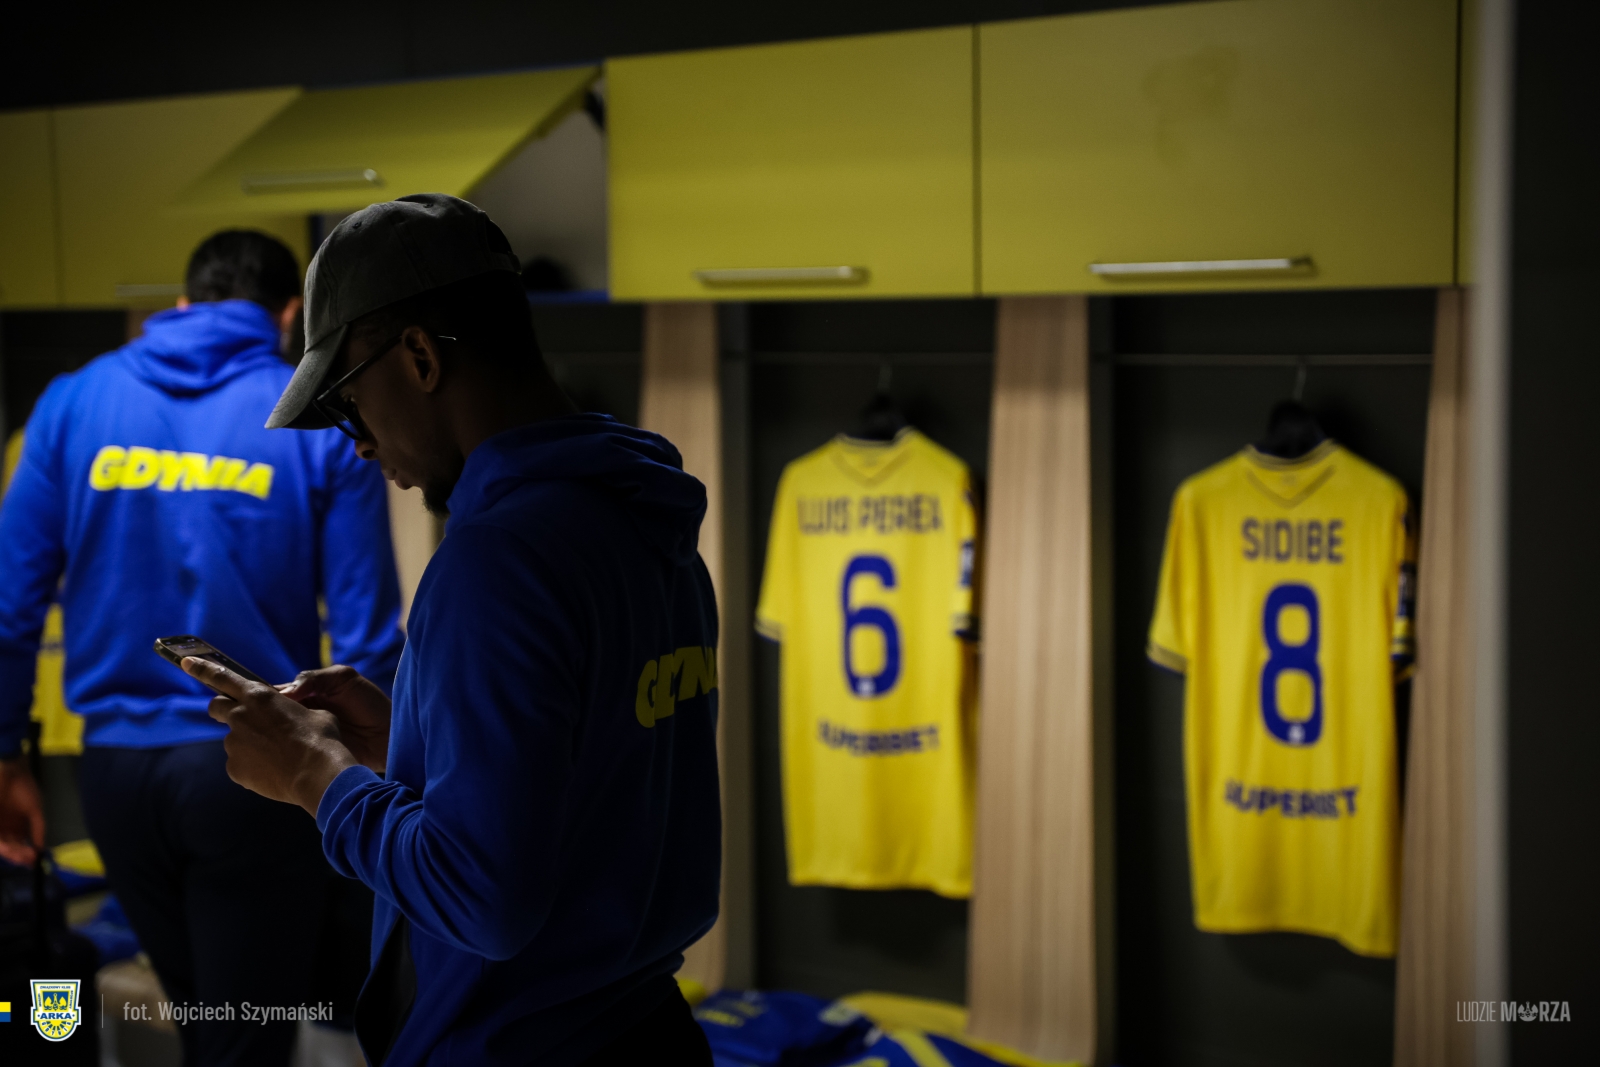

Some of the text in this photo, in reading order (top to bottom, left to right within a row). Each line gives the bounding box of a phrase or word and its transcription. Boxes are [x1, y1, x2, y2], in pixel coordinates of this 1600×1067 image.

[89, 445, 275, 500] GDYNIA
[798, 494, 850, 536] LUIS
[1241, 515, 1346, 565] SIDIBE
[841, 553, 903, 700] 6
[1259, 579, 1323, 748] 8
